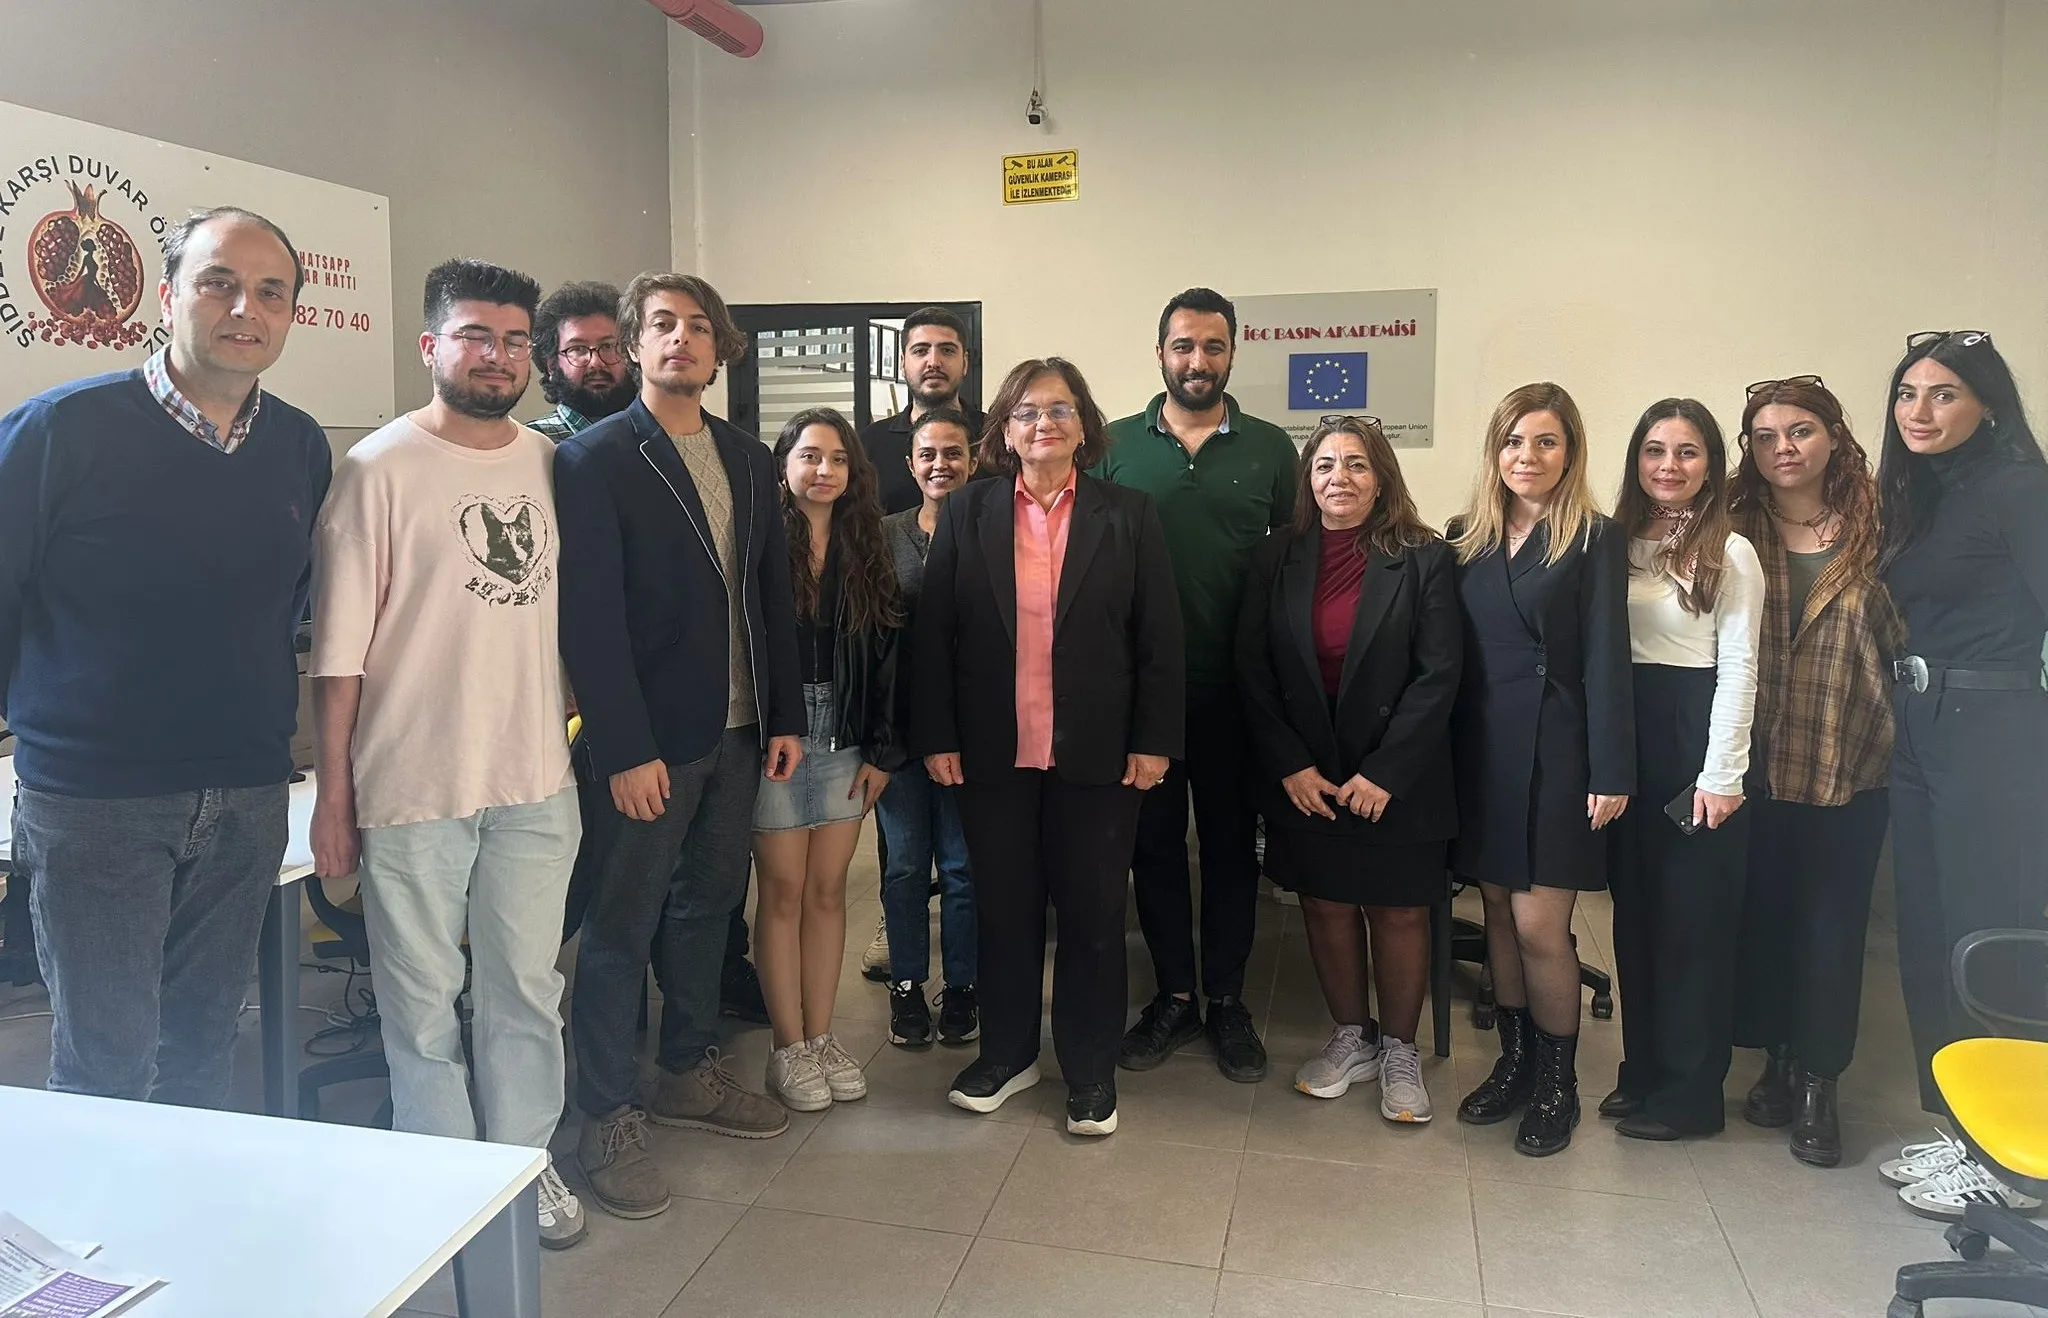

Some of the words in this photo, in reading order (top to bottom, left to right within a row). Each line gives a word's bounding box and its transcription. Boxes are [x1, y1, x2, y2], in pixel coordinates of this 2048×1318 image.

[1026, 159, 1036, 169] BU
[1037, 158, 1053, 169] ALAN
[0, 155, 60, 216] KARŞI
[68, 154, 149, 212] DUVAR
[1008, 172, 1040, 185] GÜVENLİK
[1040, 170, 1072, 183] KAMERASI
[1010, 187, 1020, 199] İLE
[299, 251, 350, 273] HATSAPP
[325, 272, 356, 290] HATTI
[324, 308, 344, 329] 70
[350, 312, 370, 332] 40
[1274, 326, 1321, 340] BASIN
[1324, 319, 1416, 338] AKADEMİSİ
